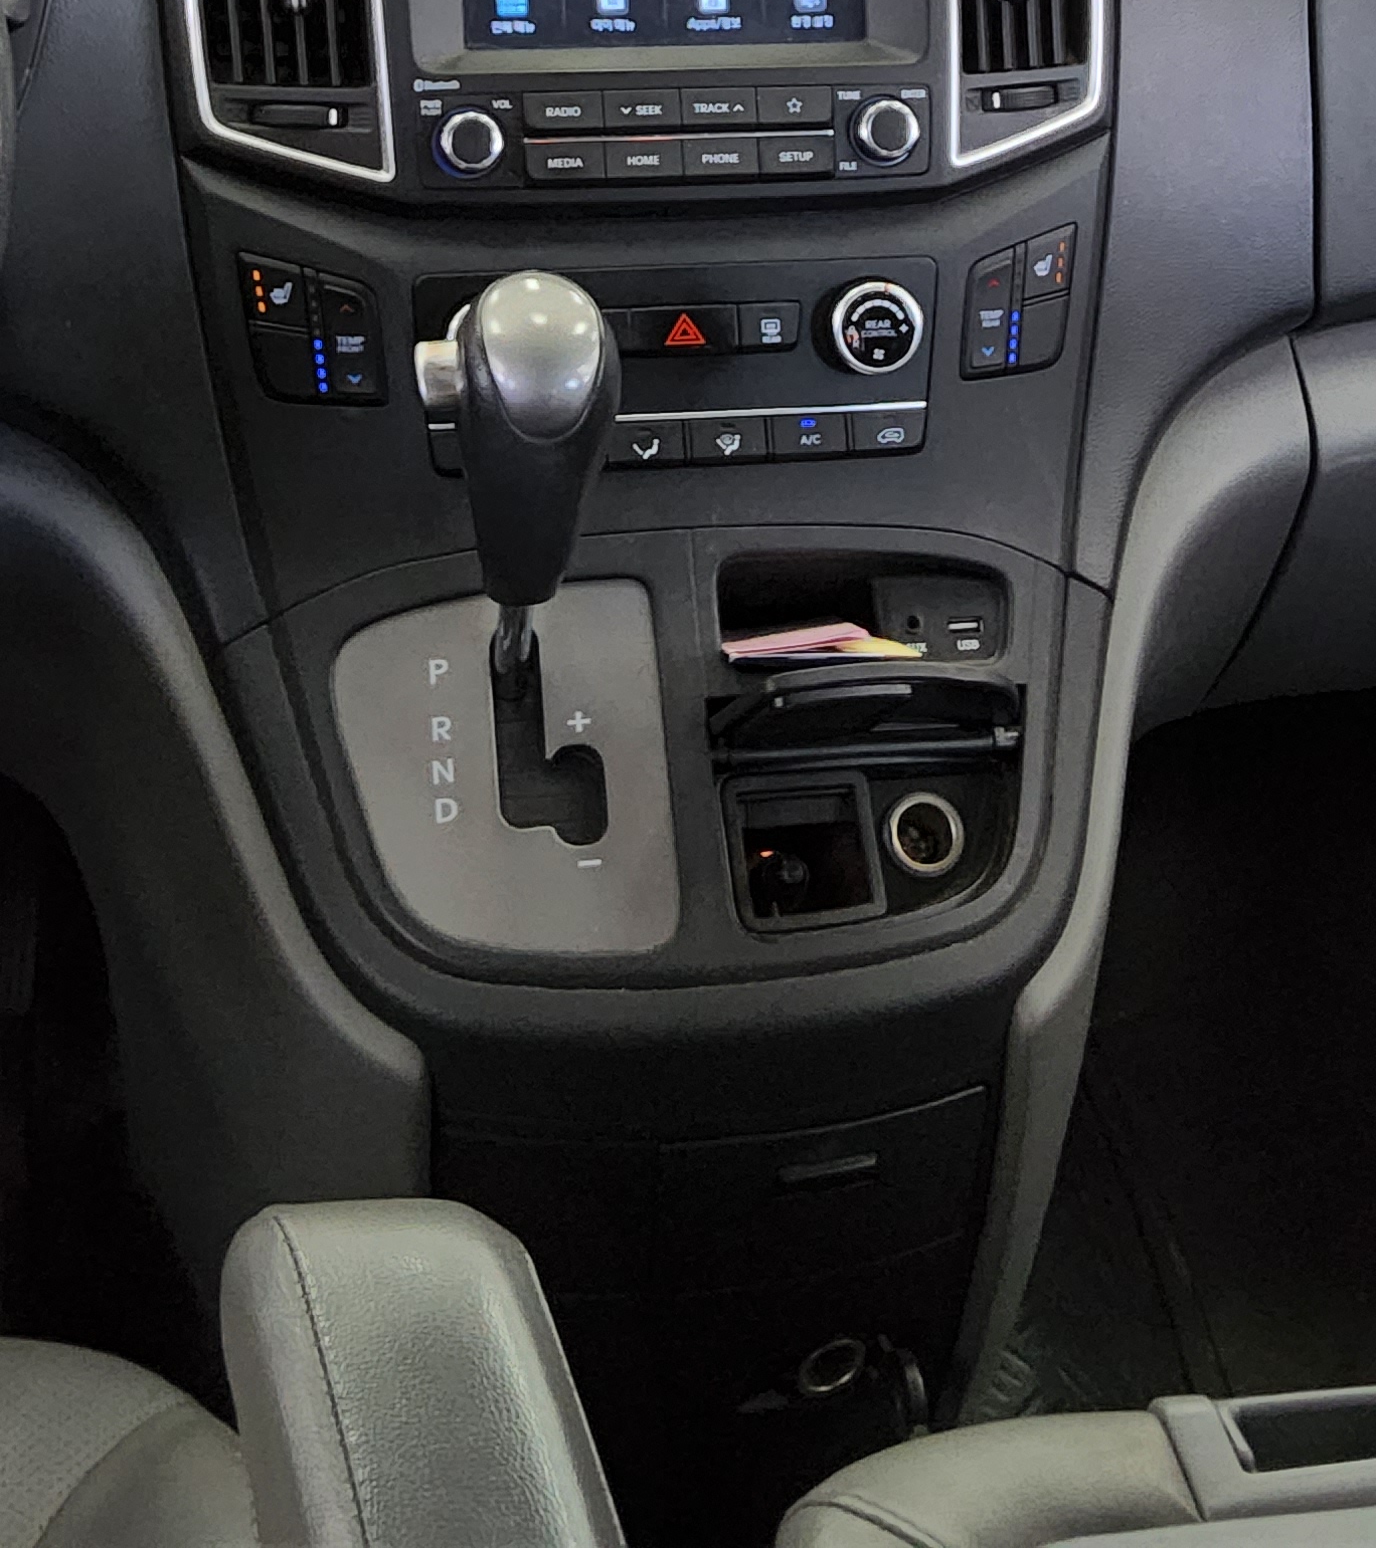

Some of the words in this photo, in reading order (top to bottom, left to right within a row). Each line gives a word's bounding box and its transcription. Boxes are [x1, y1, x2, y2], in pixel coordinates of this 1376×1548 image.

[491, 99, 513, 109] VOL
[635, 104, 663, 116] SEEK
[692, 102, 730, 113] TRACK
[545, 106, 582, 118] RADIO
[547, 157, 584, 169] MEDIA
[626, 154, 661, 166] HOME
[701, 153, 740, 165] PHONE
[778, 151, 814, 163] SETUP
[799, 433, 822, 446] A/C
[957, 639, 980, 651] USB
[428, 658, 449, 685] P
[431, 716, 453, 742] R
[431, 758, 455, 785] N
[434, 798, 459, 825] D
